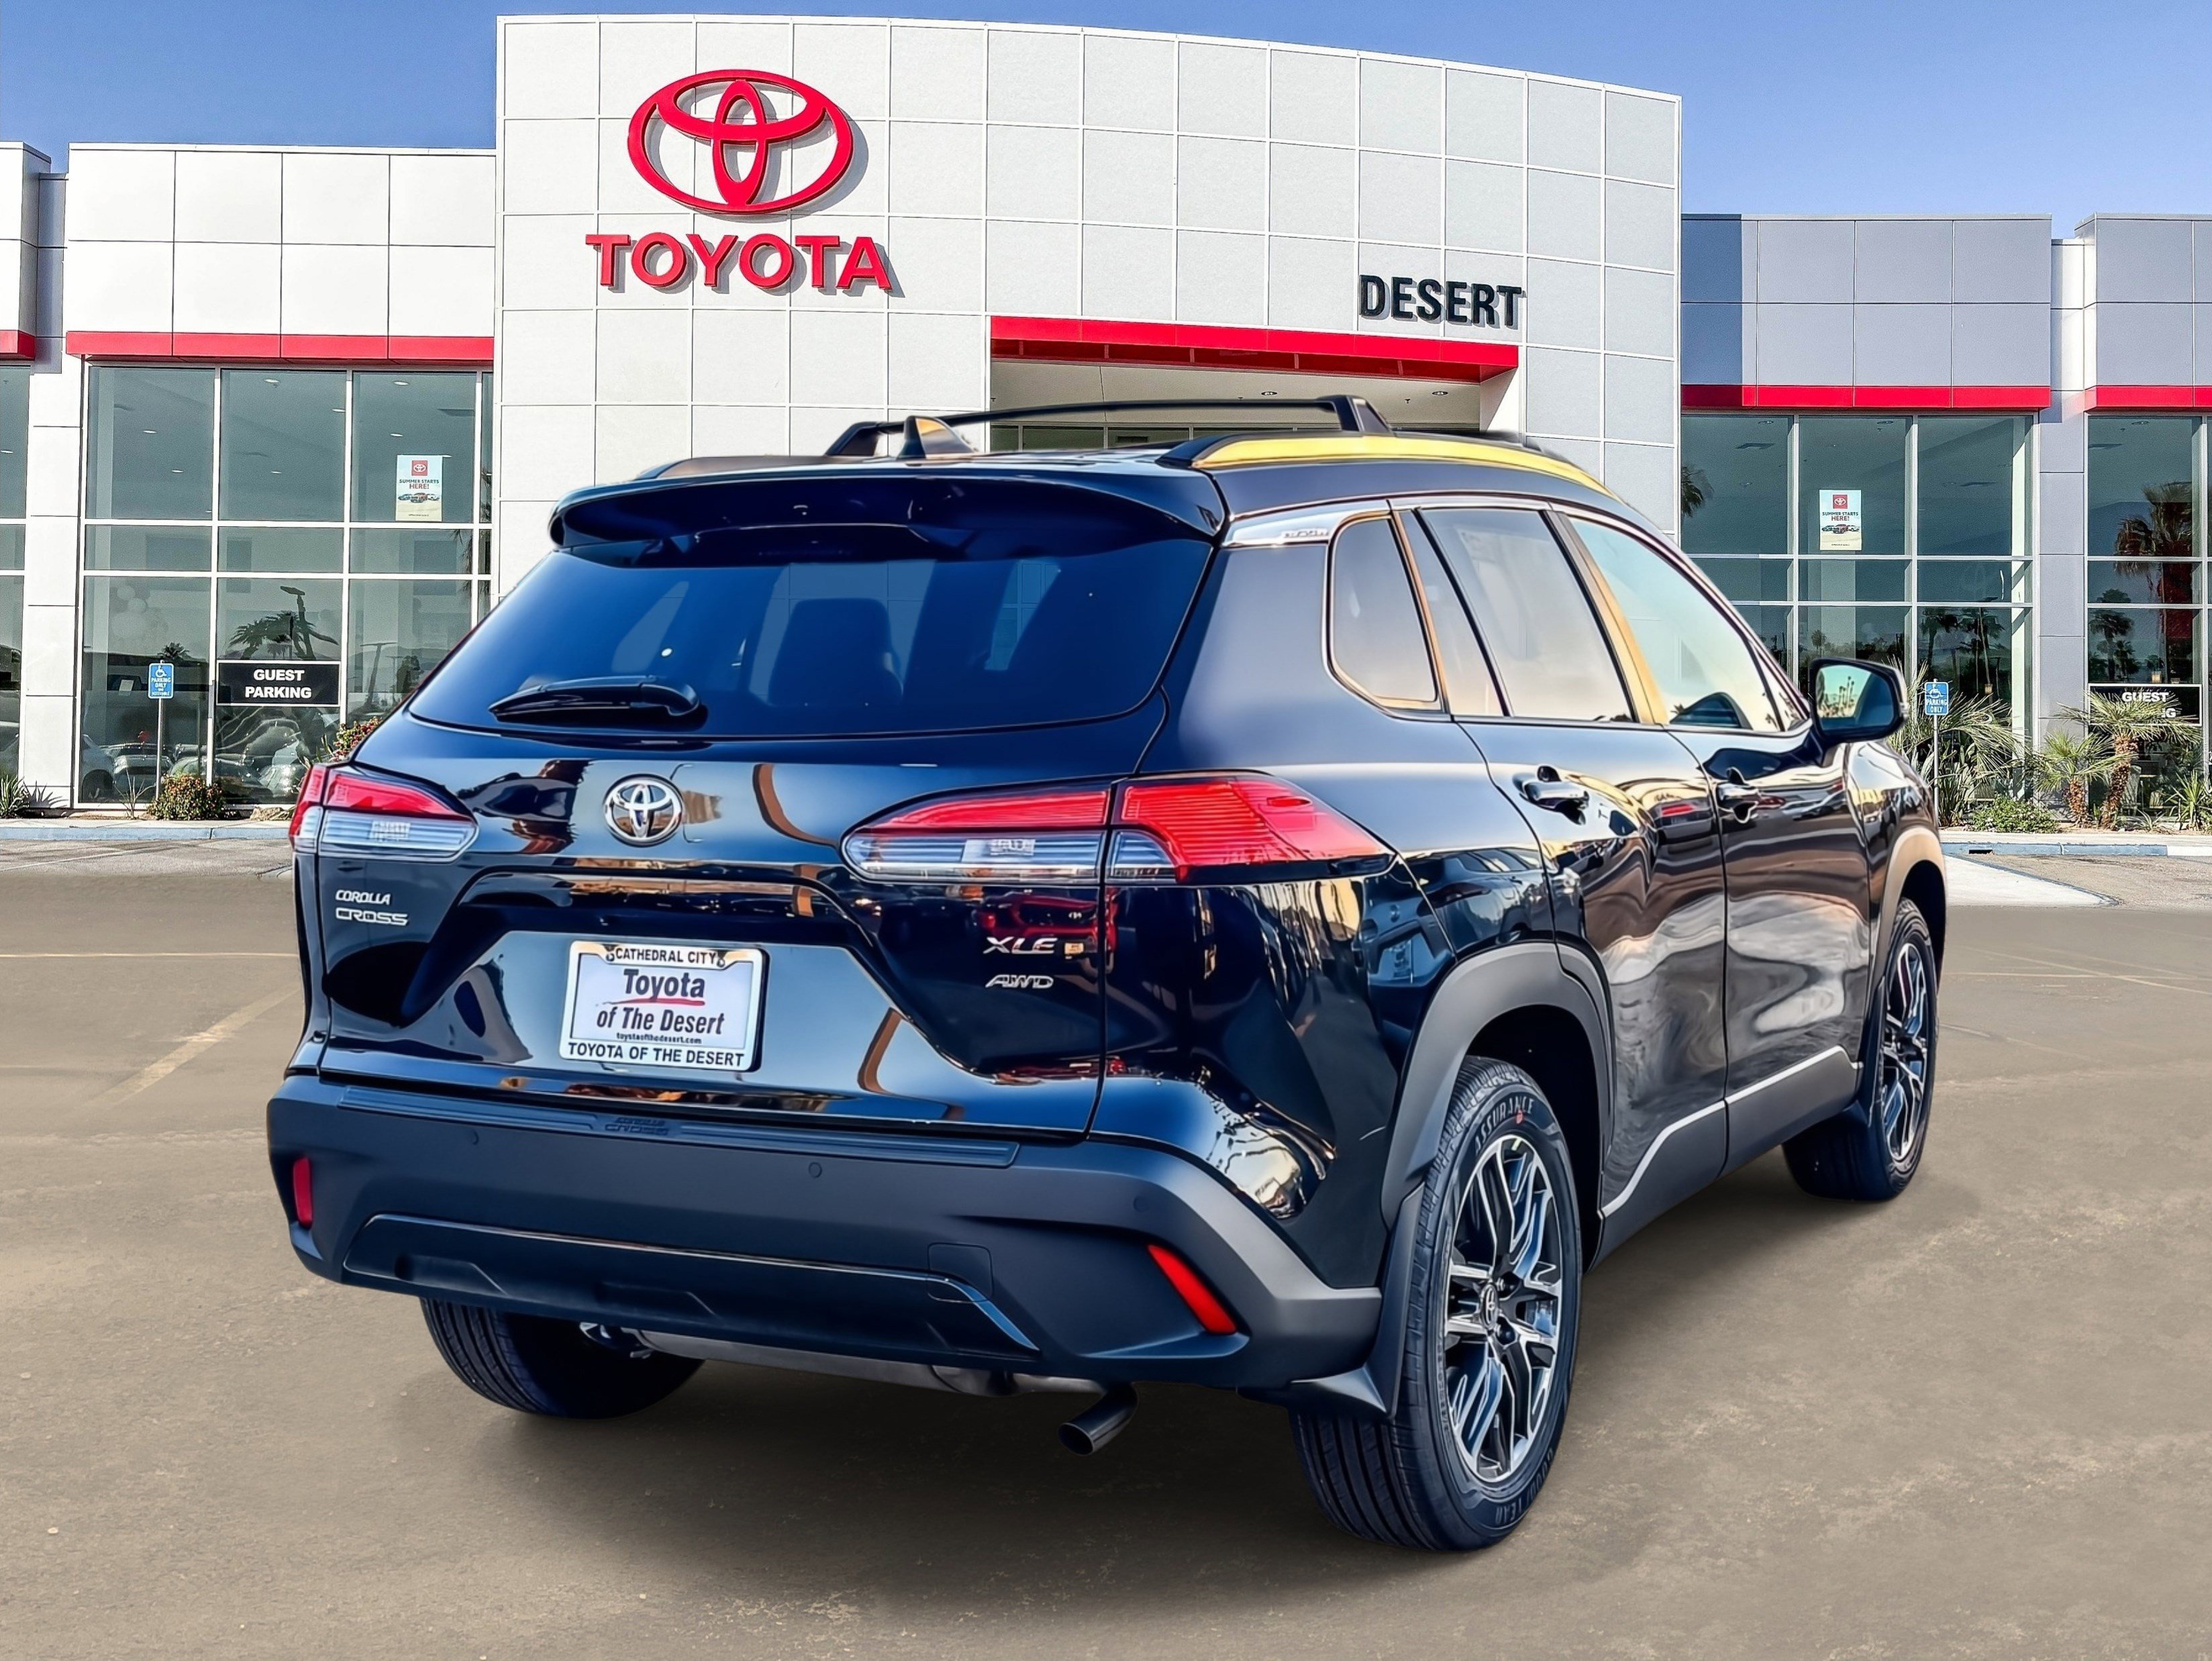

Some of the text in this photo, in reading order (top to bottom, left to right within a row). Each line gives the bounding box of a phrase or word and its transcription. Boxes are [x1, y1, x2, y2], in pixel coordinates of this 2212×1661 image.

[585, 232, 893, 291] TOYOTA
[1358, 274, 1523, 327] DESERT
[253, 669, 305, 681] GUEST
[245, 686, 312, 699] PARKING
[2121, 691, 2170, 703] GUEST
[336, 889, 391, 905] COROLLA
[336, 907, 409, 926] CROSS
[983, 936, 1058, 954] XLE
[615, 947, 716, 964] CATHEDRAL CITY
[623, 968, 705, 1002] Toyota
[985, 974, 1054, 989] AWD
[596, 1007, 725, 1035] of The Desert
[568, 1042, 745, 1067] TOYOTA OF THE DESERT
[1475, 1095, 1535, 1156] ASSURANCE
